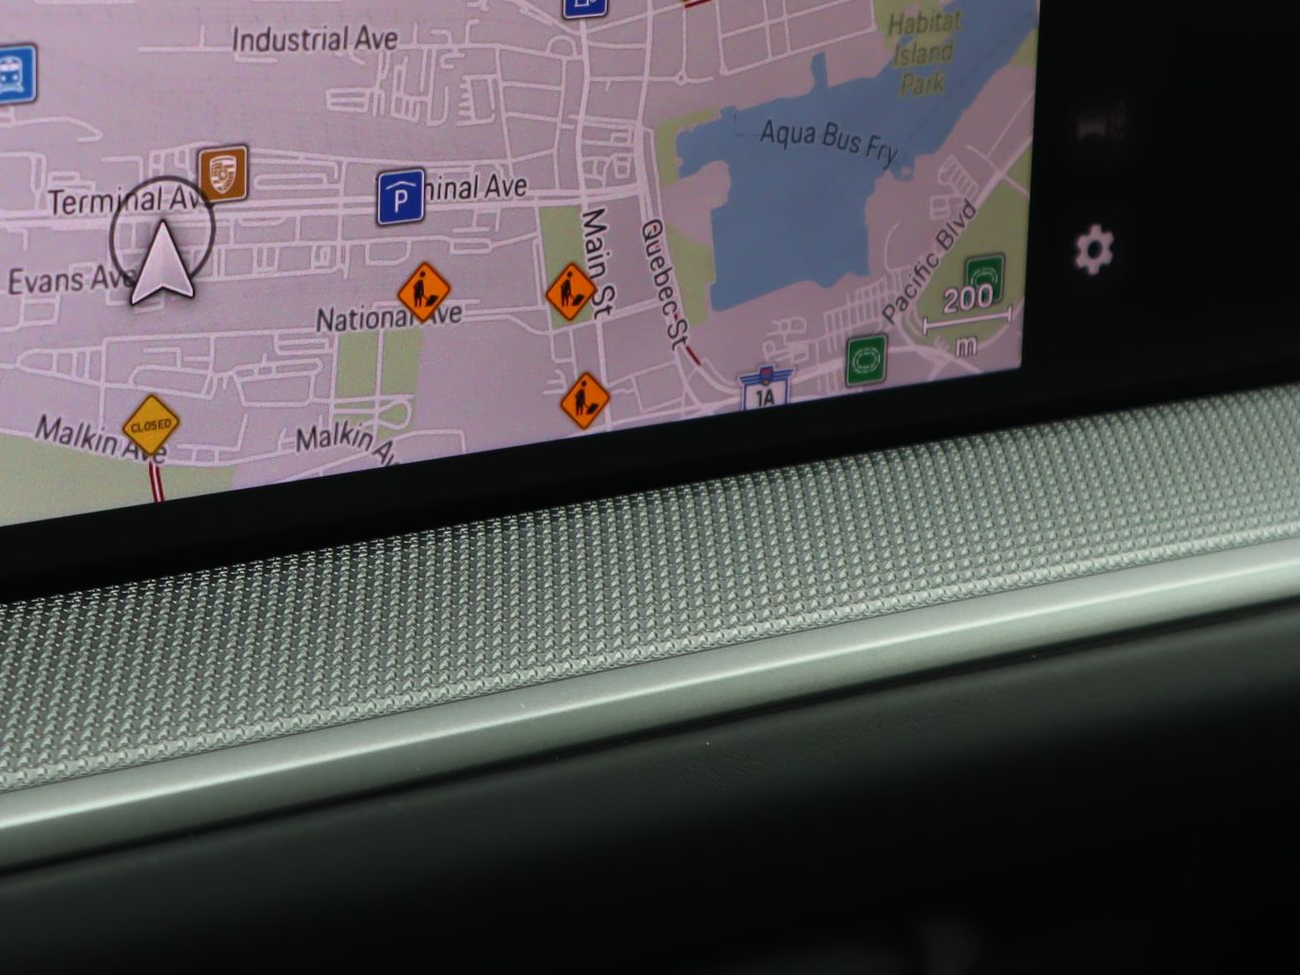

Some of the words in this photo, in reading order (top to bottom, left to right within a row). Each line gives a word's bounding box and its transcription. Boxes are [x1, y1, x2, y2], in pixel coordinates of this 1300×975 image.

[889, 10, 962, 35] Habitat
[232, 26, 349, 54] Industrial
[354, 26, 398, 53] Ave
[894, 40, 955, 65] Island
[901, 72, 945, 96] Park
[760, 120, 816, 150] Aqua
[823, 122, 862, 155] Bus
[864, 134, 899, 170] Fry
[485, 173, 527, 197] Ave
[48, 186, 162, 215] Terminal
[583, 208, 613, 280] Main
[882, 252, 941, 326] Pacific
[935, 199, 977, 255] Blvd
[8, 266, 84, 296] Evans
[641, 218, 679, 316] Quebec
[667, 318, 689, 350] St
[591, 285, 616, 318] St
[944, 283, 994, 313] 200
[956, 336, 978, 357] m
[756, 388, 774, 406] 1A
[35, 414, 117, 455] Malkin
[131, 418, 172, 433] CLOSED
[296, 420, 374, 452] Malkin
